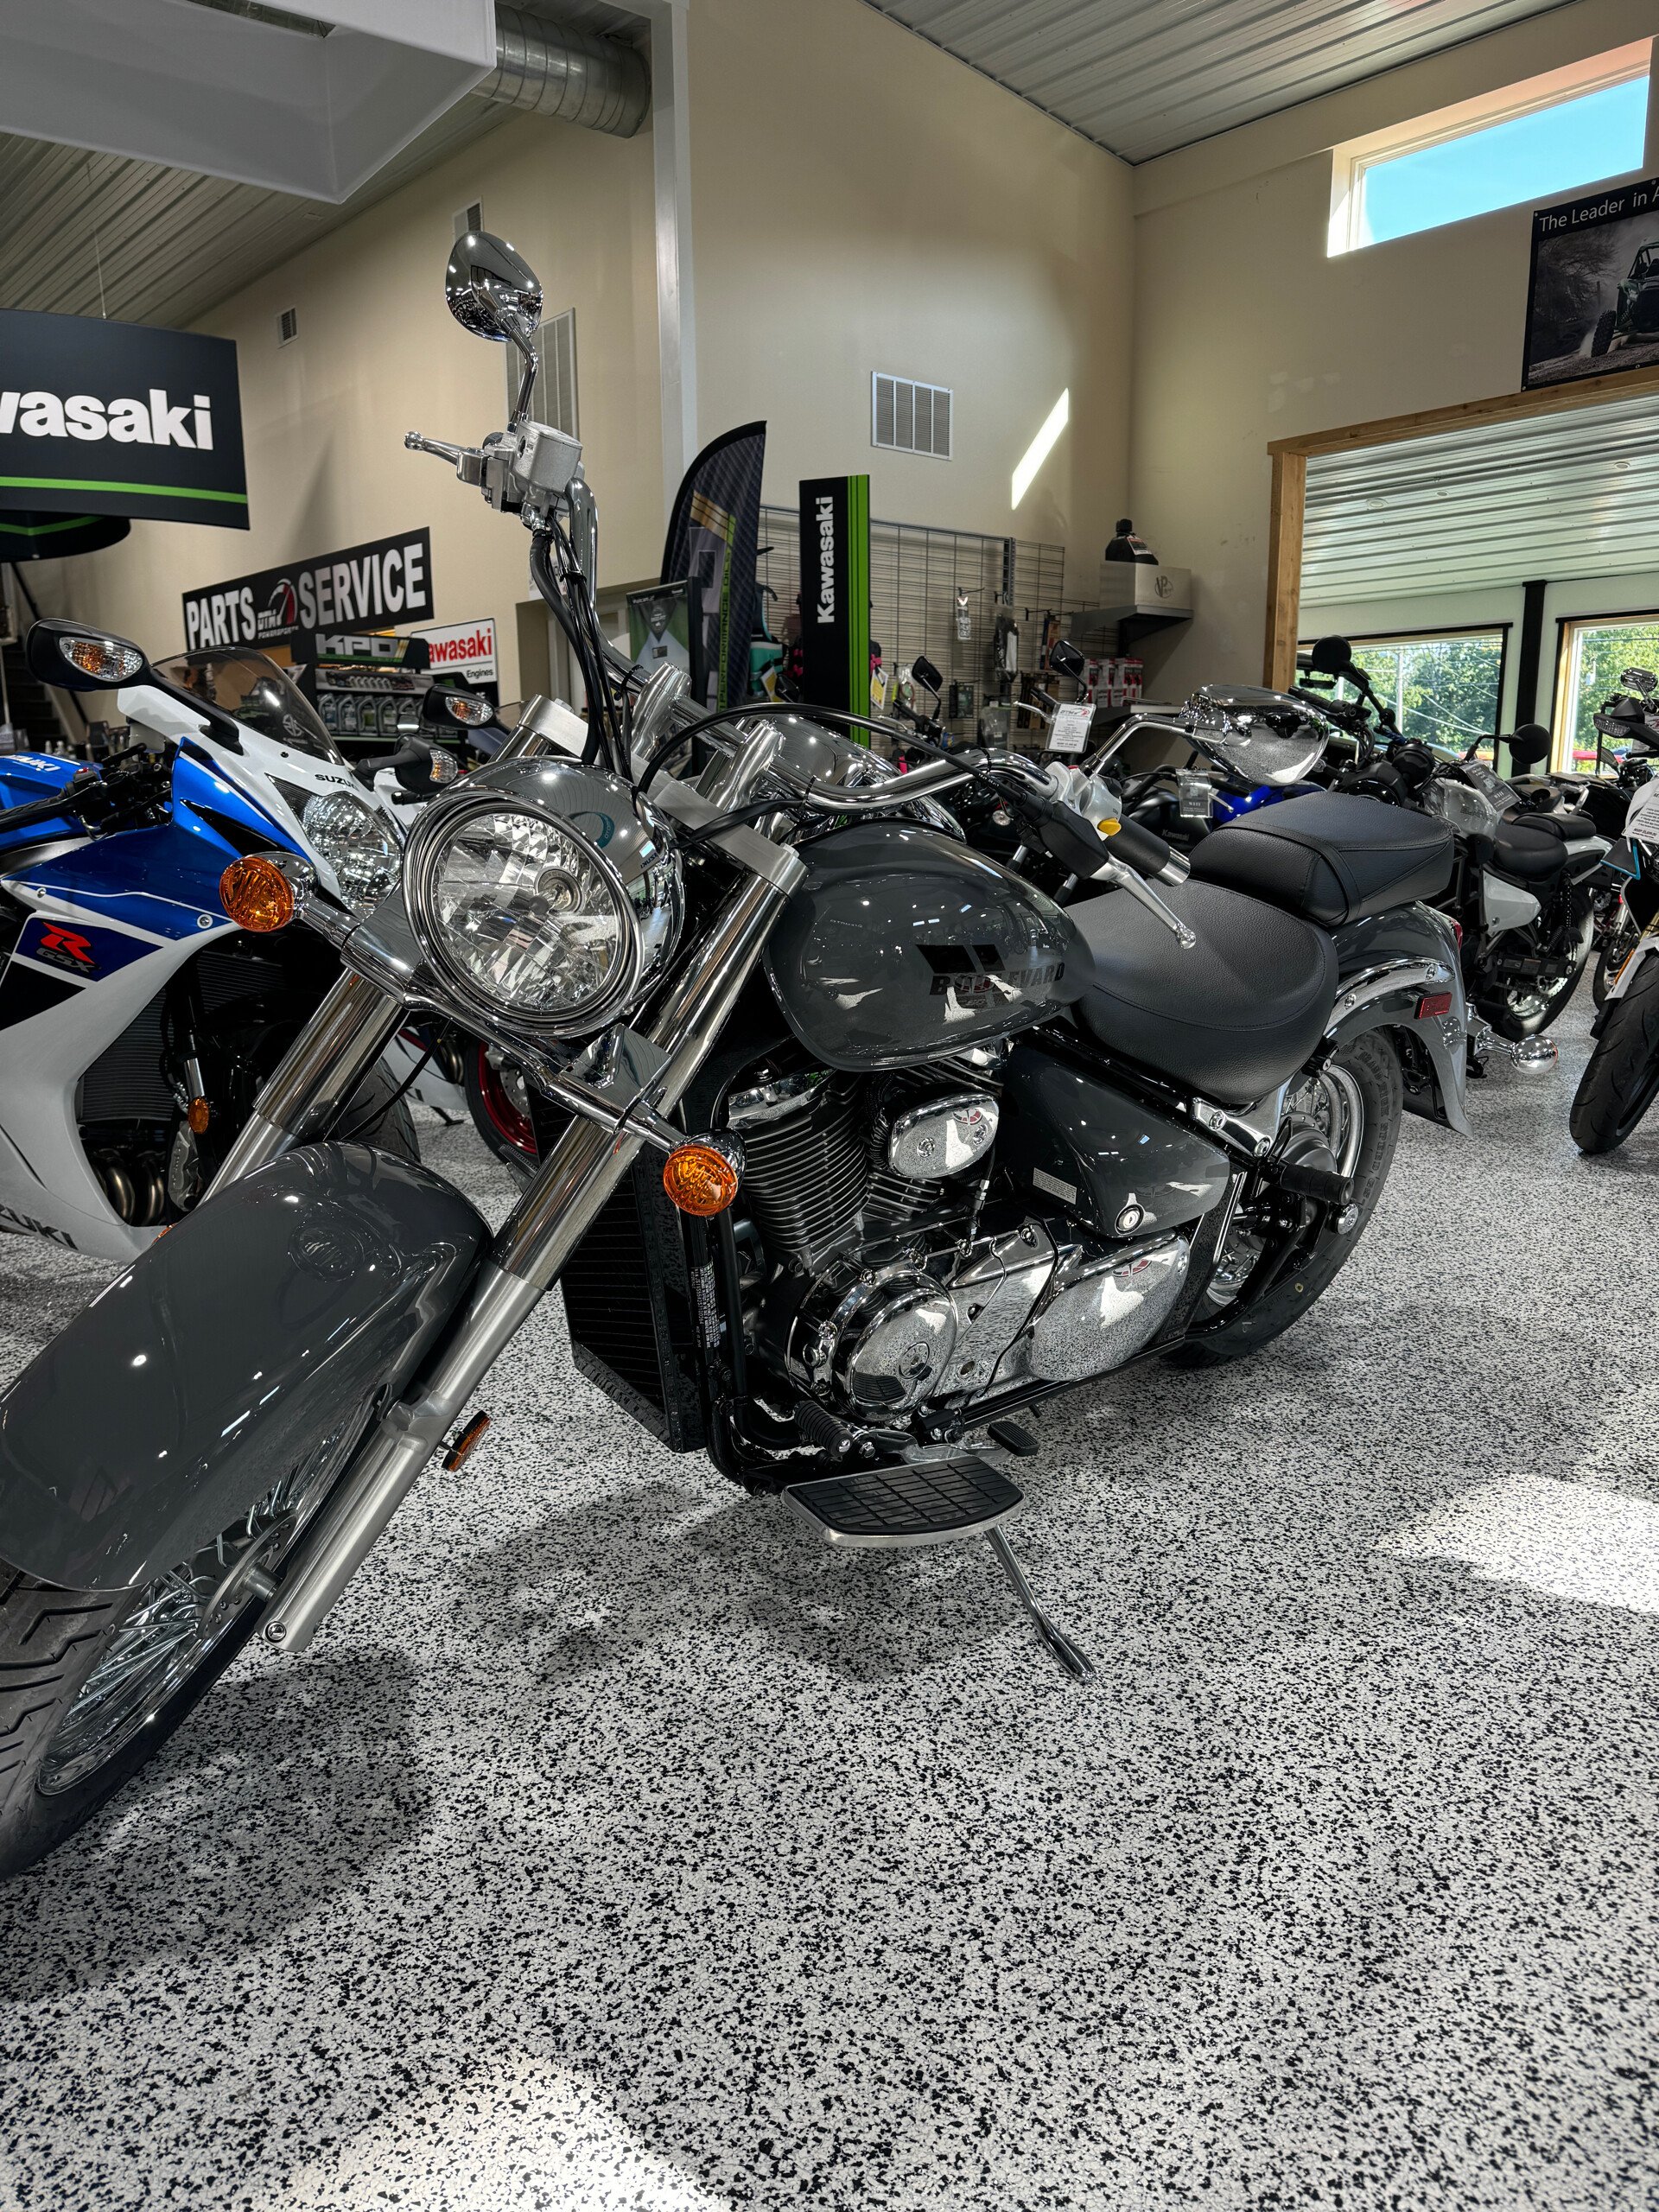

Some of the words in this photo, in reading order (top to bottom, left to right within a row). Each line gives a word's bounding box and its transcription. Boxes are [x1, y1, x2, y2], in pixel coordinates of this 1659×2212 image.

[1539, 214, 1567, 232] The
[1571, 199, 1625, 225] Leader
[1632, 192, 1648, 208] in
[815, 496, 836, 624] Kawasaki
[185, 586, 257, 650] PARTS
[298, 543, 427, 630] SERVICE
[315, 632, 400, 658] KPO
[719, 592, 728, 702] PERFORMANCE
[466, 668, 494, 679] Engines
[35, 947, 95, 973] GSX
[40, 921, 96, 965] R
